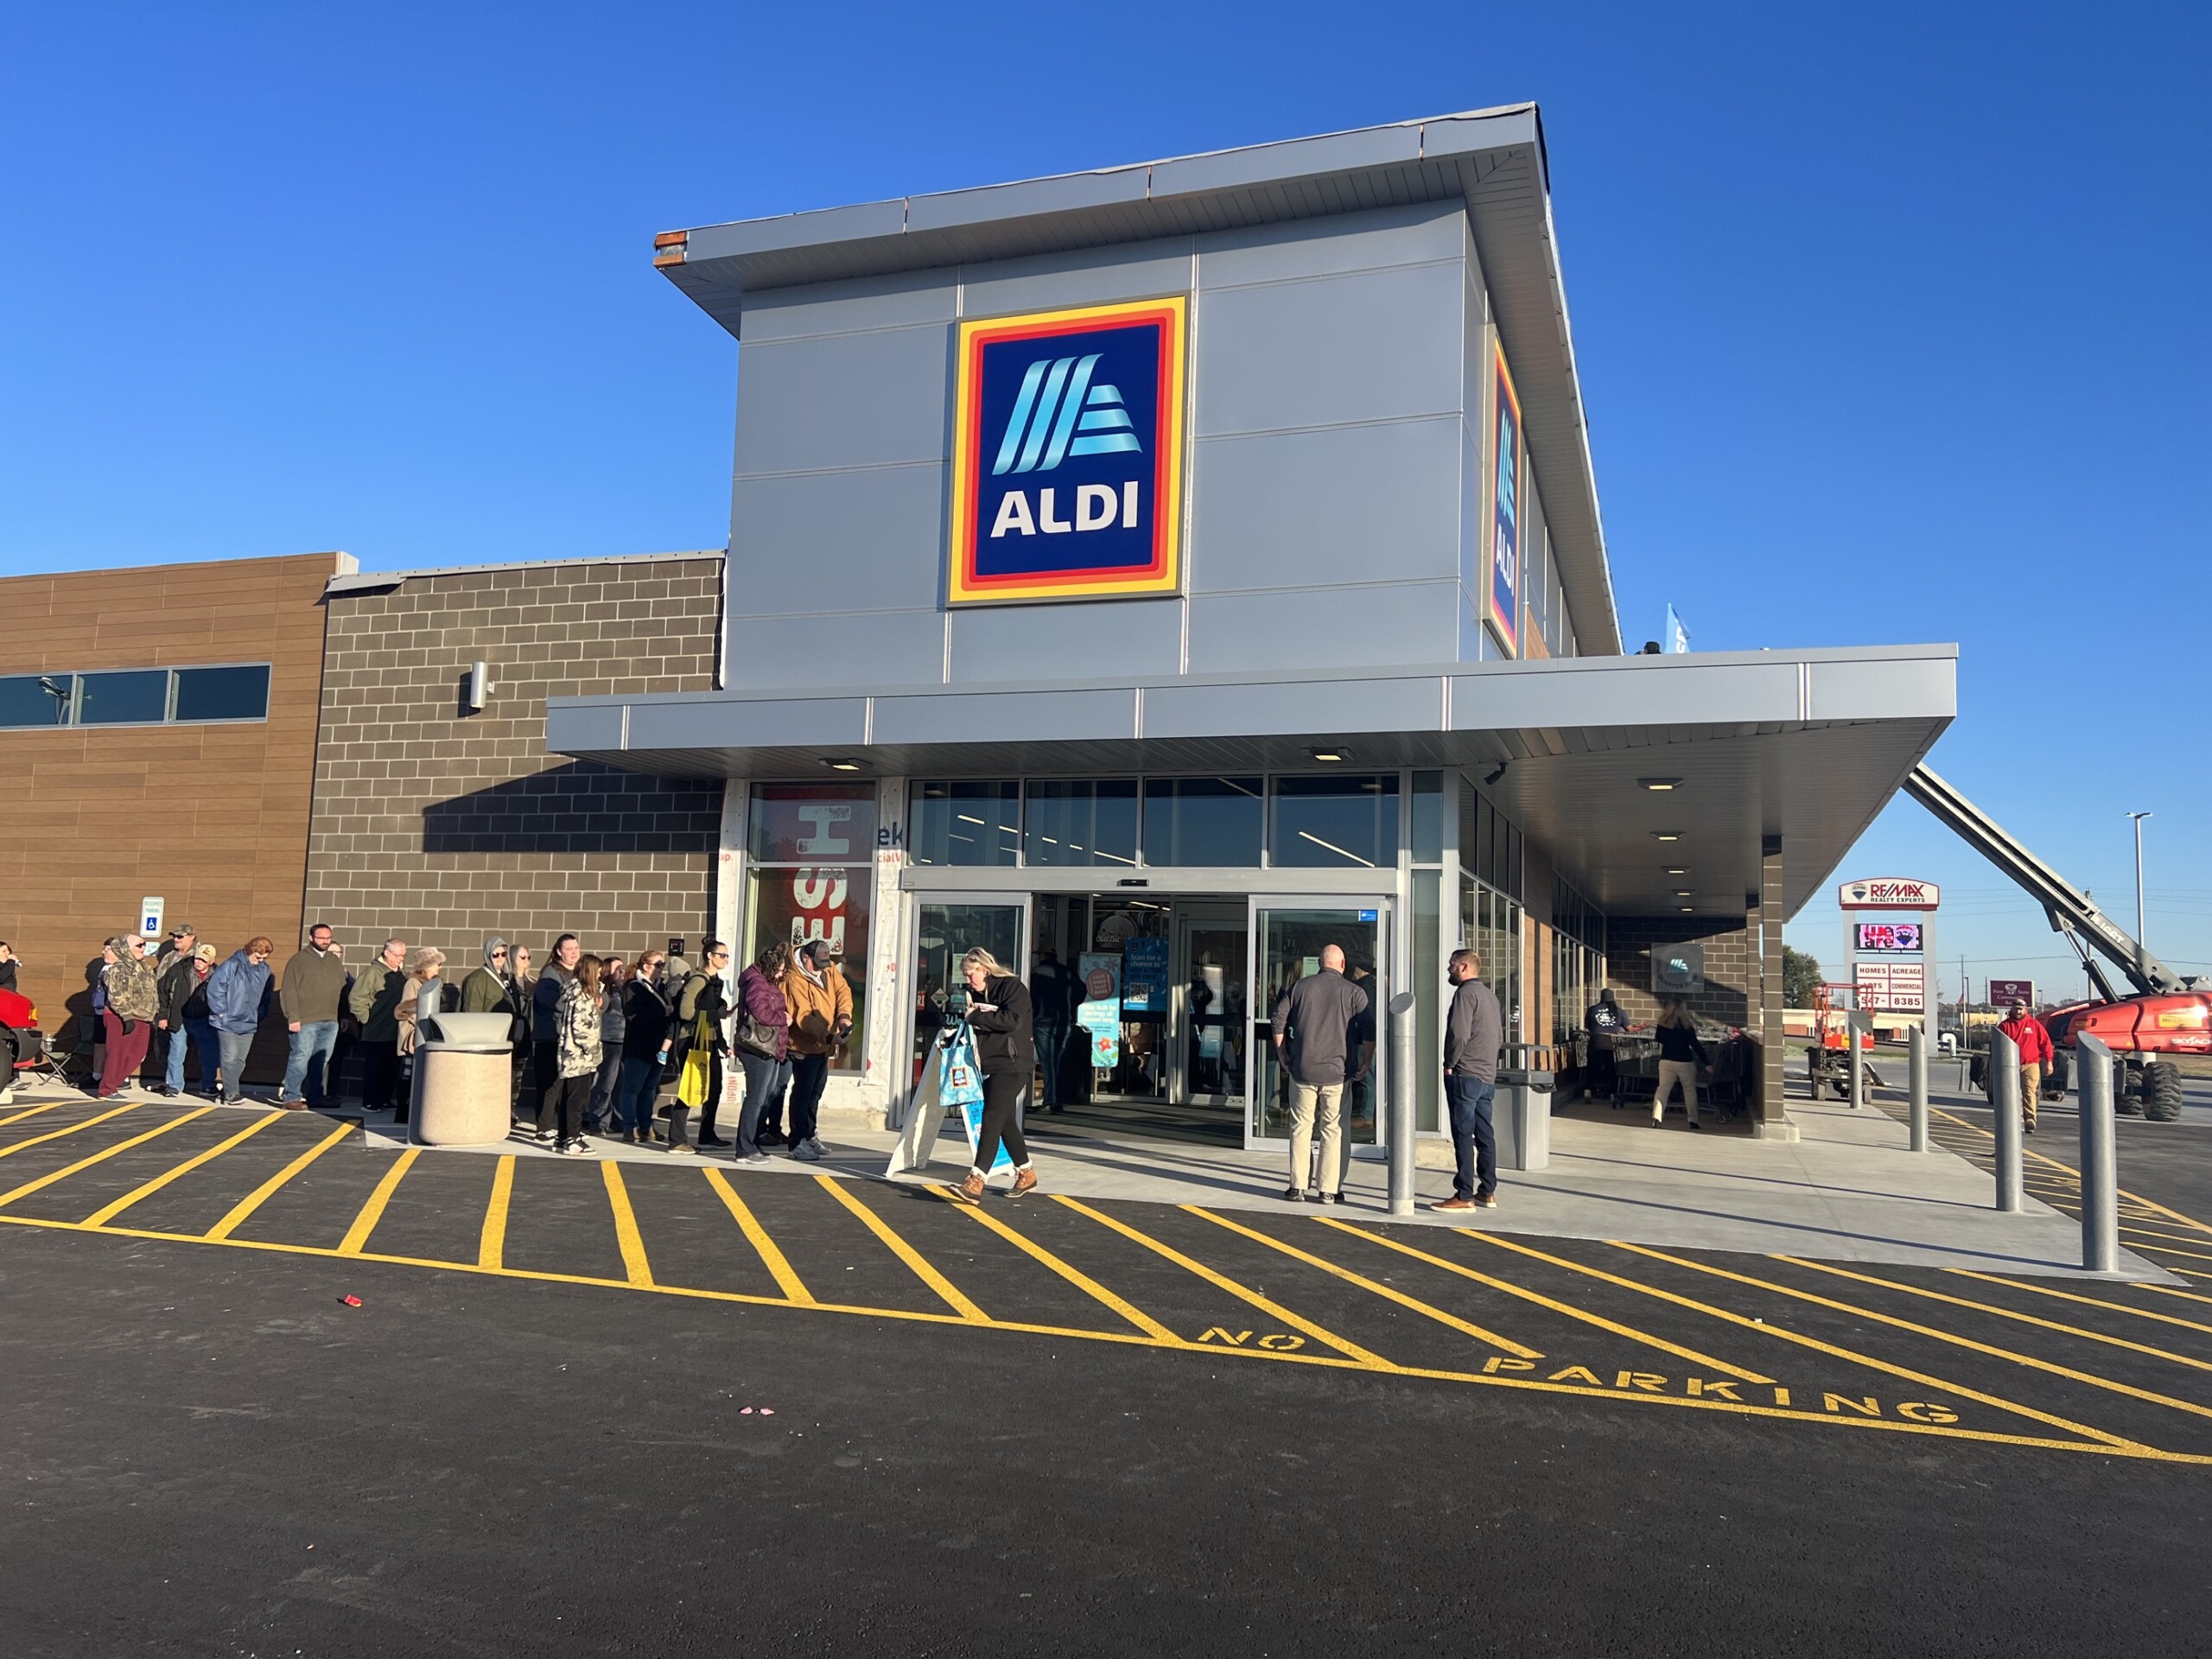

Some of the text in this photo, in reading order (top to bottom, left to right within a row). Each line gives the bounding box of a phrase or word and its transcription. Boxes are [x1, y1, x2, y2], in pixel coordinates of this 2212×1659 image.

[990, 481, 1139, 538] ALDI
[1496, 522, 1516, 596] ALDI
[1871, 883, 1924, 898] RE/MAX
[1894, 997, 1921, 1006] 8385
[1198, 1326, 1959, 1423] NO PARKING
